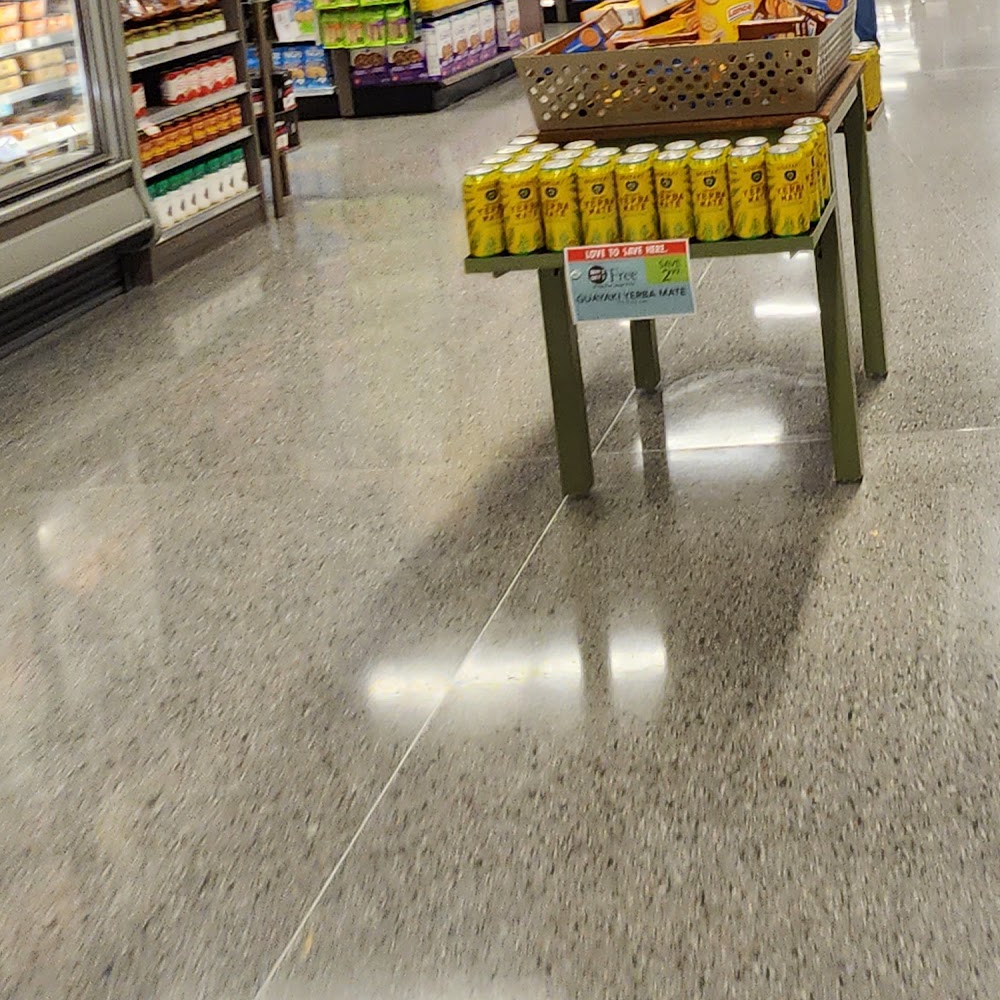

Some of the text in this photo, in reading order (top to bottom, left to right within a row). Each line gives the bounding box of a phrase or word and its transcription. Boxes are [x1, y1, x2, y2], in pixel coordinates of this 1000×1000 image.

[585, 249, 606, 260] LOVE
[608, 248, 620, 258] TO
[622, 246, 643, 257] SAVE
[610, 267, 638, 282] Free
[576, 291, 621, 304] GUAYAKI
[623, 289, 655, 301] YERBA
[659, 287, 687, 297] MATE
